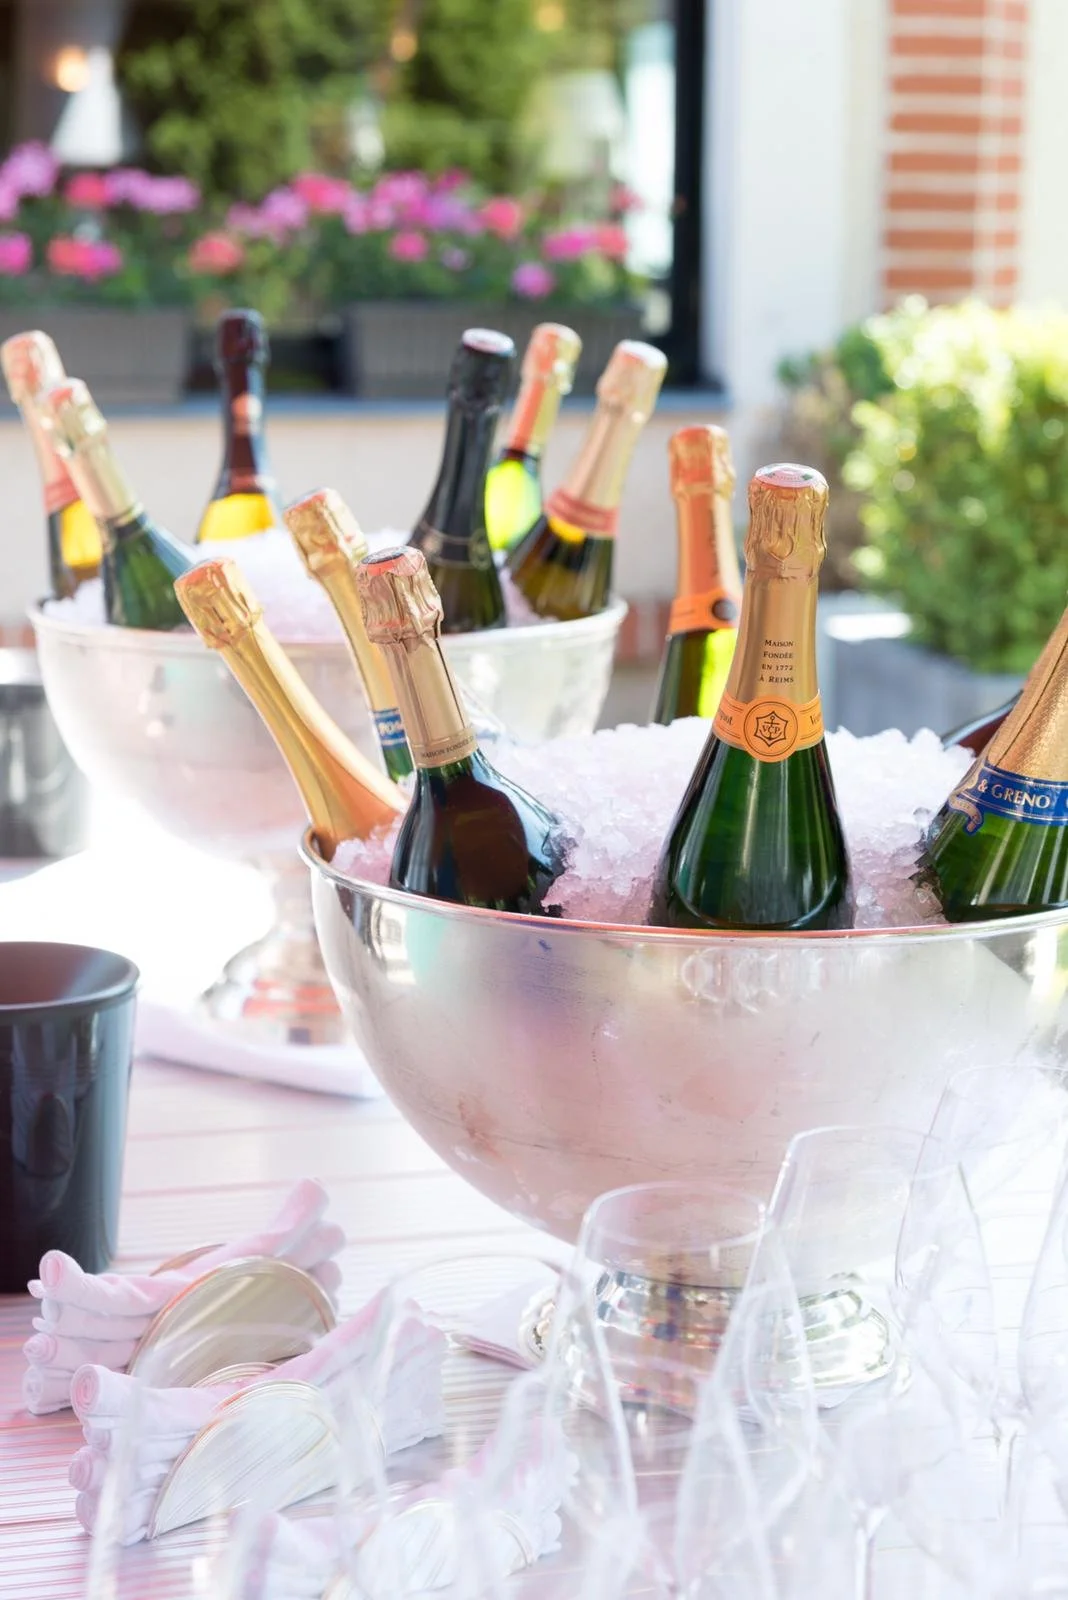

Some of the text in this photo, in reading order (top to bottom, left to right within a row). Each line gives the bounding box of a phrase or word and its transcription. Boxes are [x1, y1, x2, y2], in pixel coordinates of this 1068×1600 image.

[764, 639, 794, 647] MAISON
[768, 675, 794, 683] REIMS
[977, 778, 988, 793] &
[991, 784, 1051, 809] GRENO
